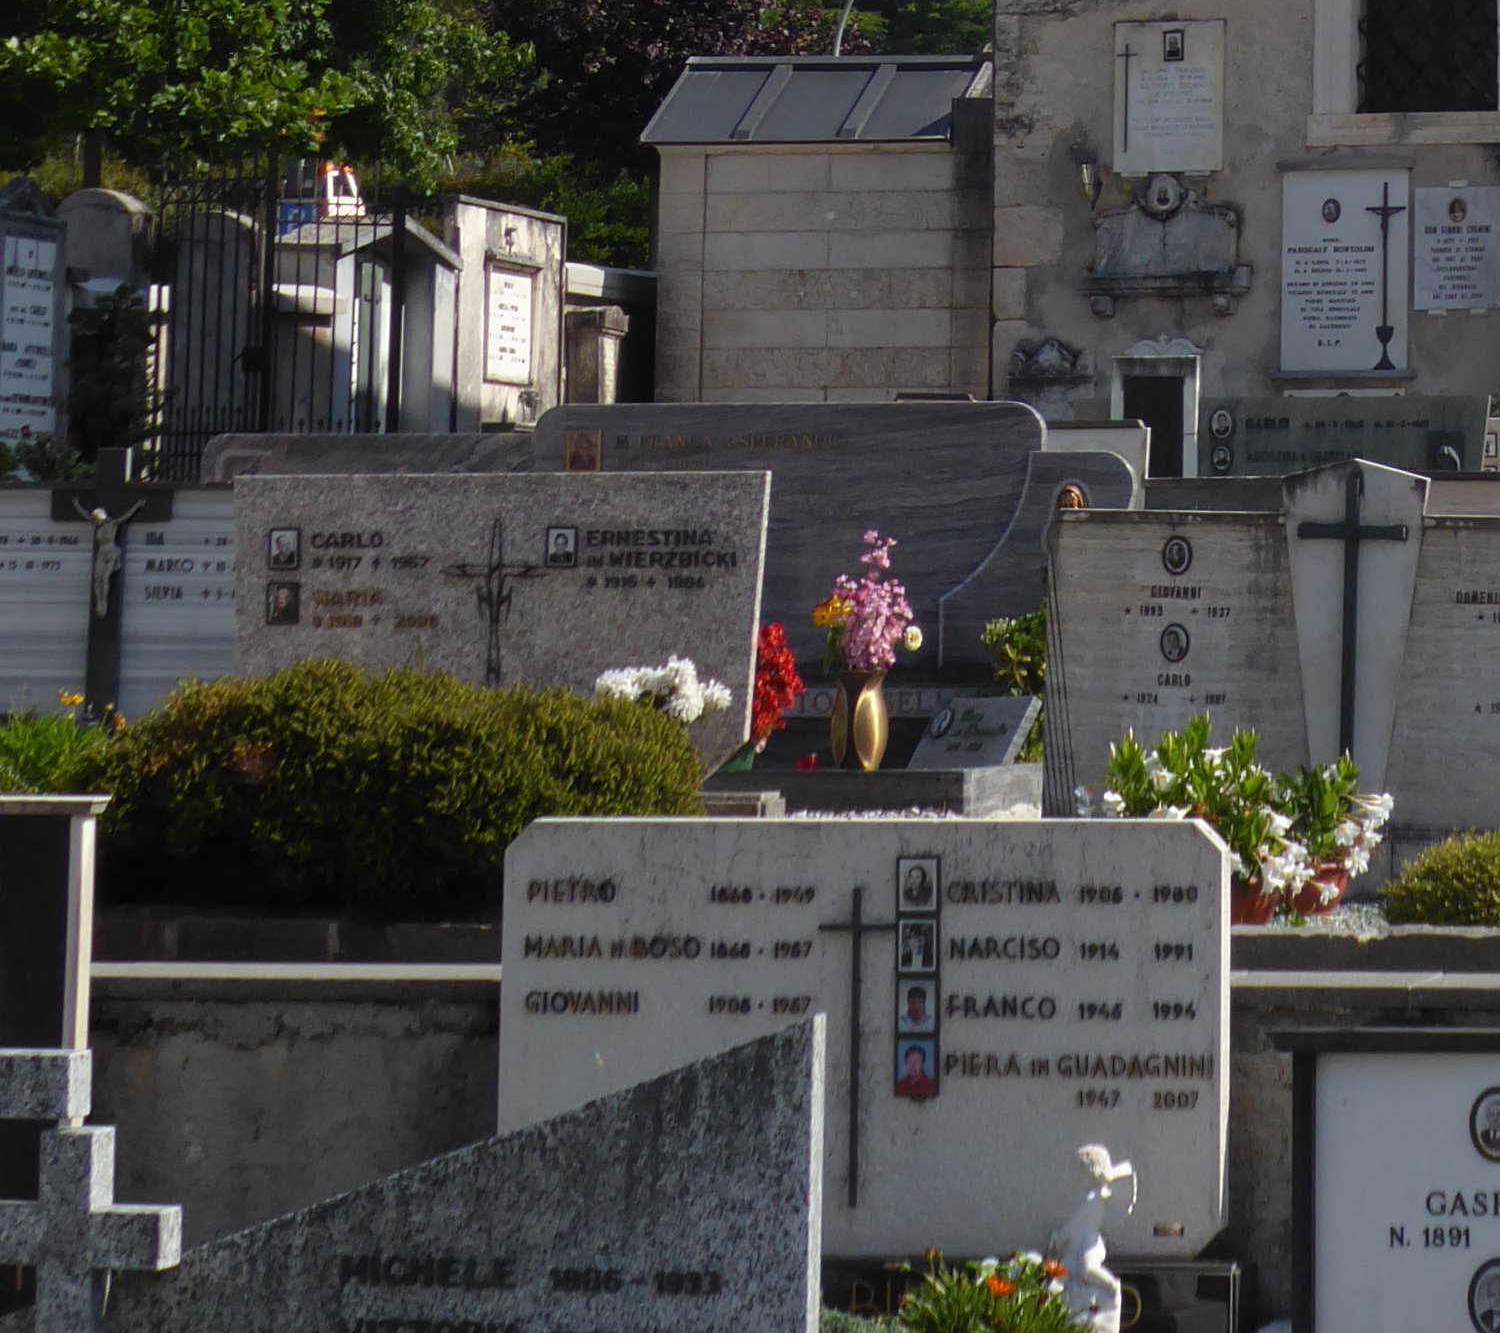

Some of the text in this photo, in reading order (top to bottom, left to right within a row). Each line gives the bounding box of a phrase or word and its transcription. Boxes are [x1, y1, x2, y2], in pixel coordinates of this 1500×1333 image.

[311, 532, 384, 549] CARLO
[585, 529, 713, 547] ERNESTINA
[144, 558, 196, 572] MARCO
[609, 551, 737, 568] WIERZBICKI
[144, 584, 184, 600] SILVIA
[312, 587, 384, 606] MARIA
[1150, 585, 1202, 599] GIOVANNI
[1157, 673, 1191, 687] CARLO
[526, 878, 617, 904] PIETRO
[947, 880, 1061, 904] CRISTINA
[524, 934, 602, 959] MARIA
[629, 933, 701, 960] BOSO
[950, 936, 1061, 961] NARCISO
[1154, 942, 1194, 962] 1991
[524, 990, 640, 1015] GIOVANNI
[946, 994, 1057, 1019] FRANCO
[944, 1052, 1022, 1077] PIERA
[1056, 1053, 1214, 1079] GUADAGNINI
[1152, 1089, 1199, 1110] 2007
[1389, 1225, 1412, 1248] N.
[1423, 1225, 1472, 1249] 1891
[339, 1254, 518, 1290] MICHELE
